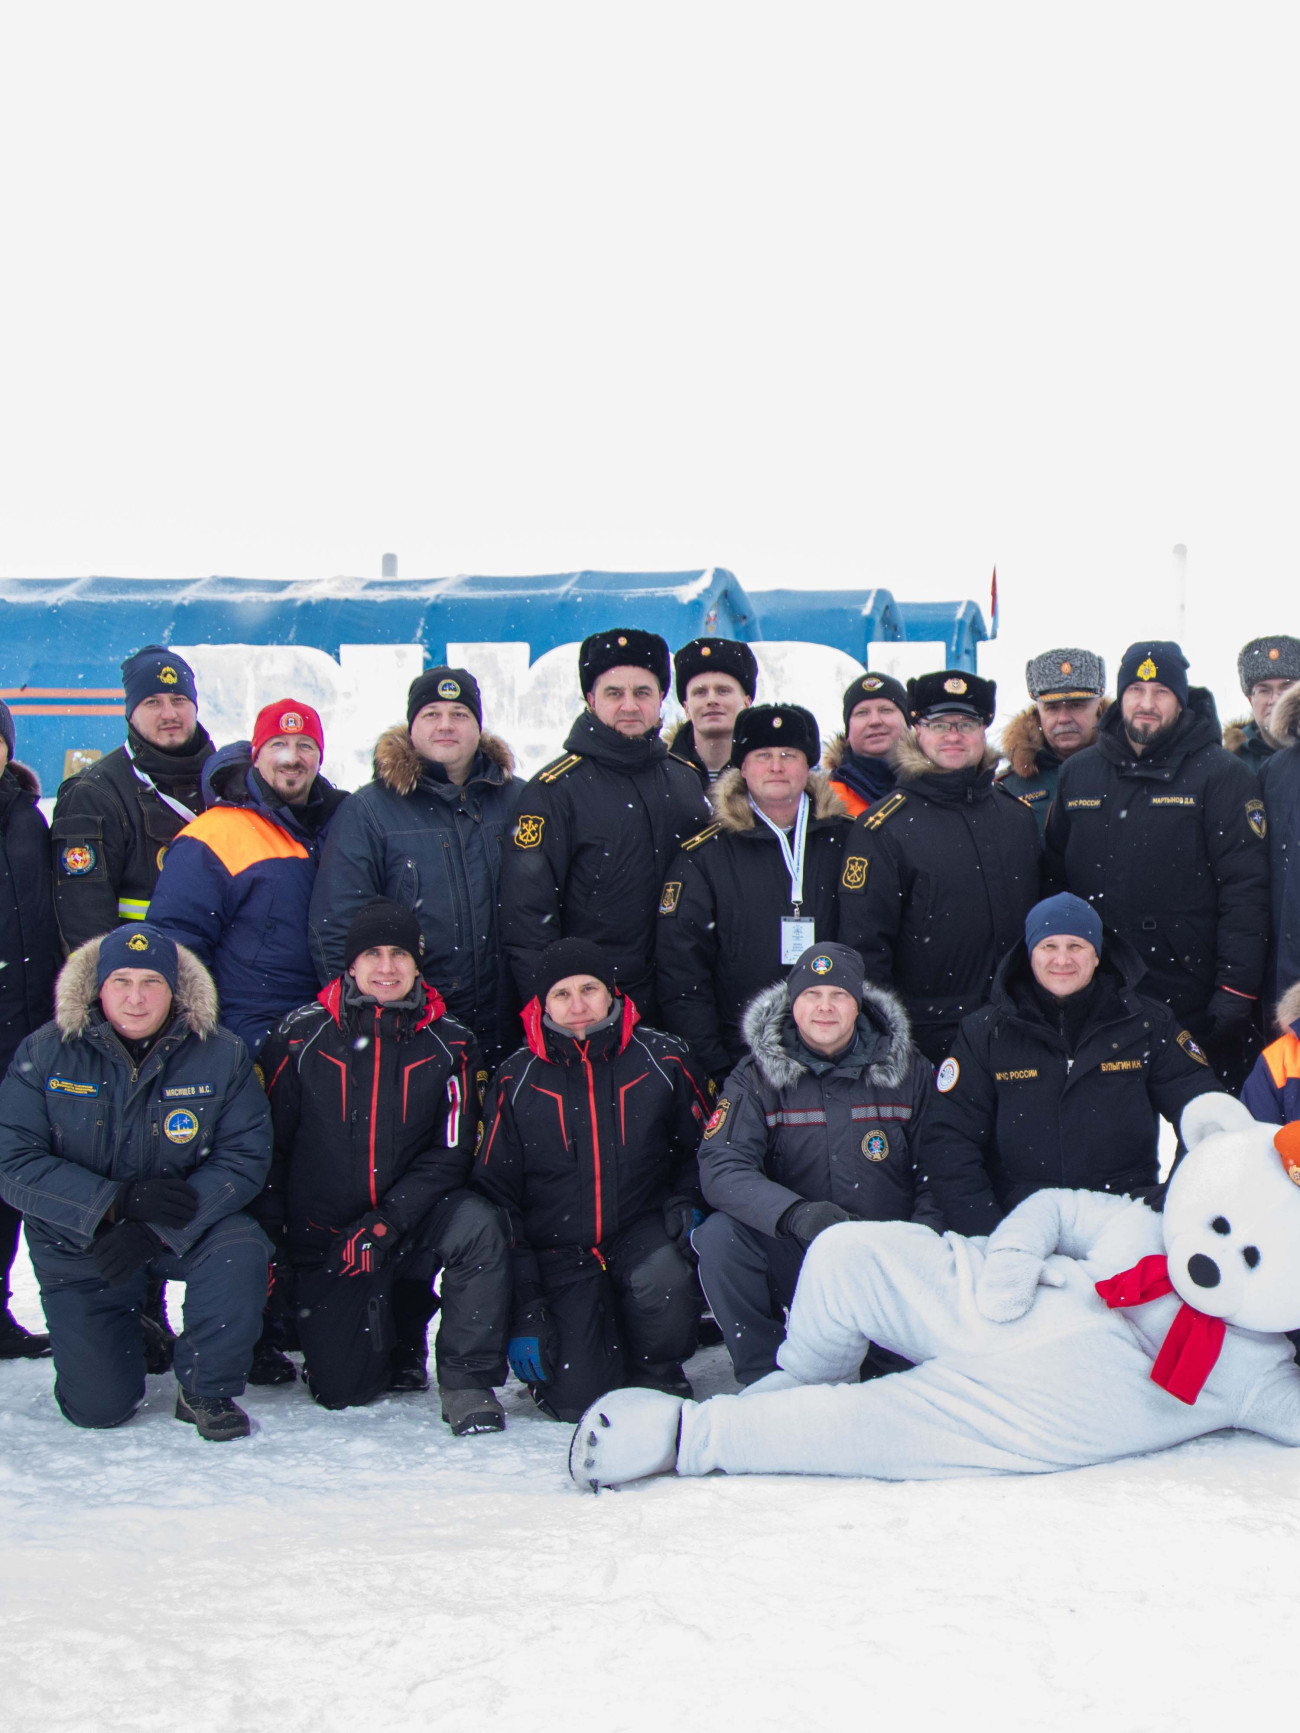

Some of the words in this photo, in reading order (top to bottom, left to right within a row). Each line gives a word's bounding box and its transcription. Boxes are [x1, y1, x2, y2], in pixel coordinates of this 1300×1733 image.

[1101, 1061, 1131, 1072] БУЛЫГИН
[995, 1072, 1009, 1081] МЧС
[1010, 1069, 1038, 1080] РОССИИ
[165, 1086, 196, 1097] МЯСИЩЕВ
[199, 1085, 212, 1094] М.С.
